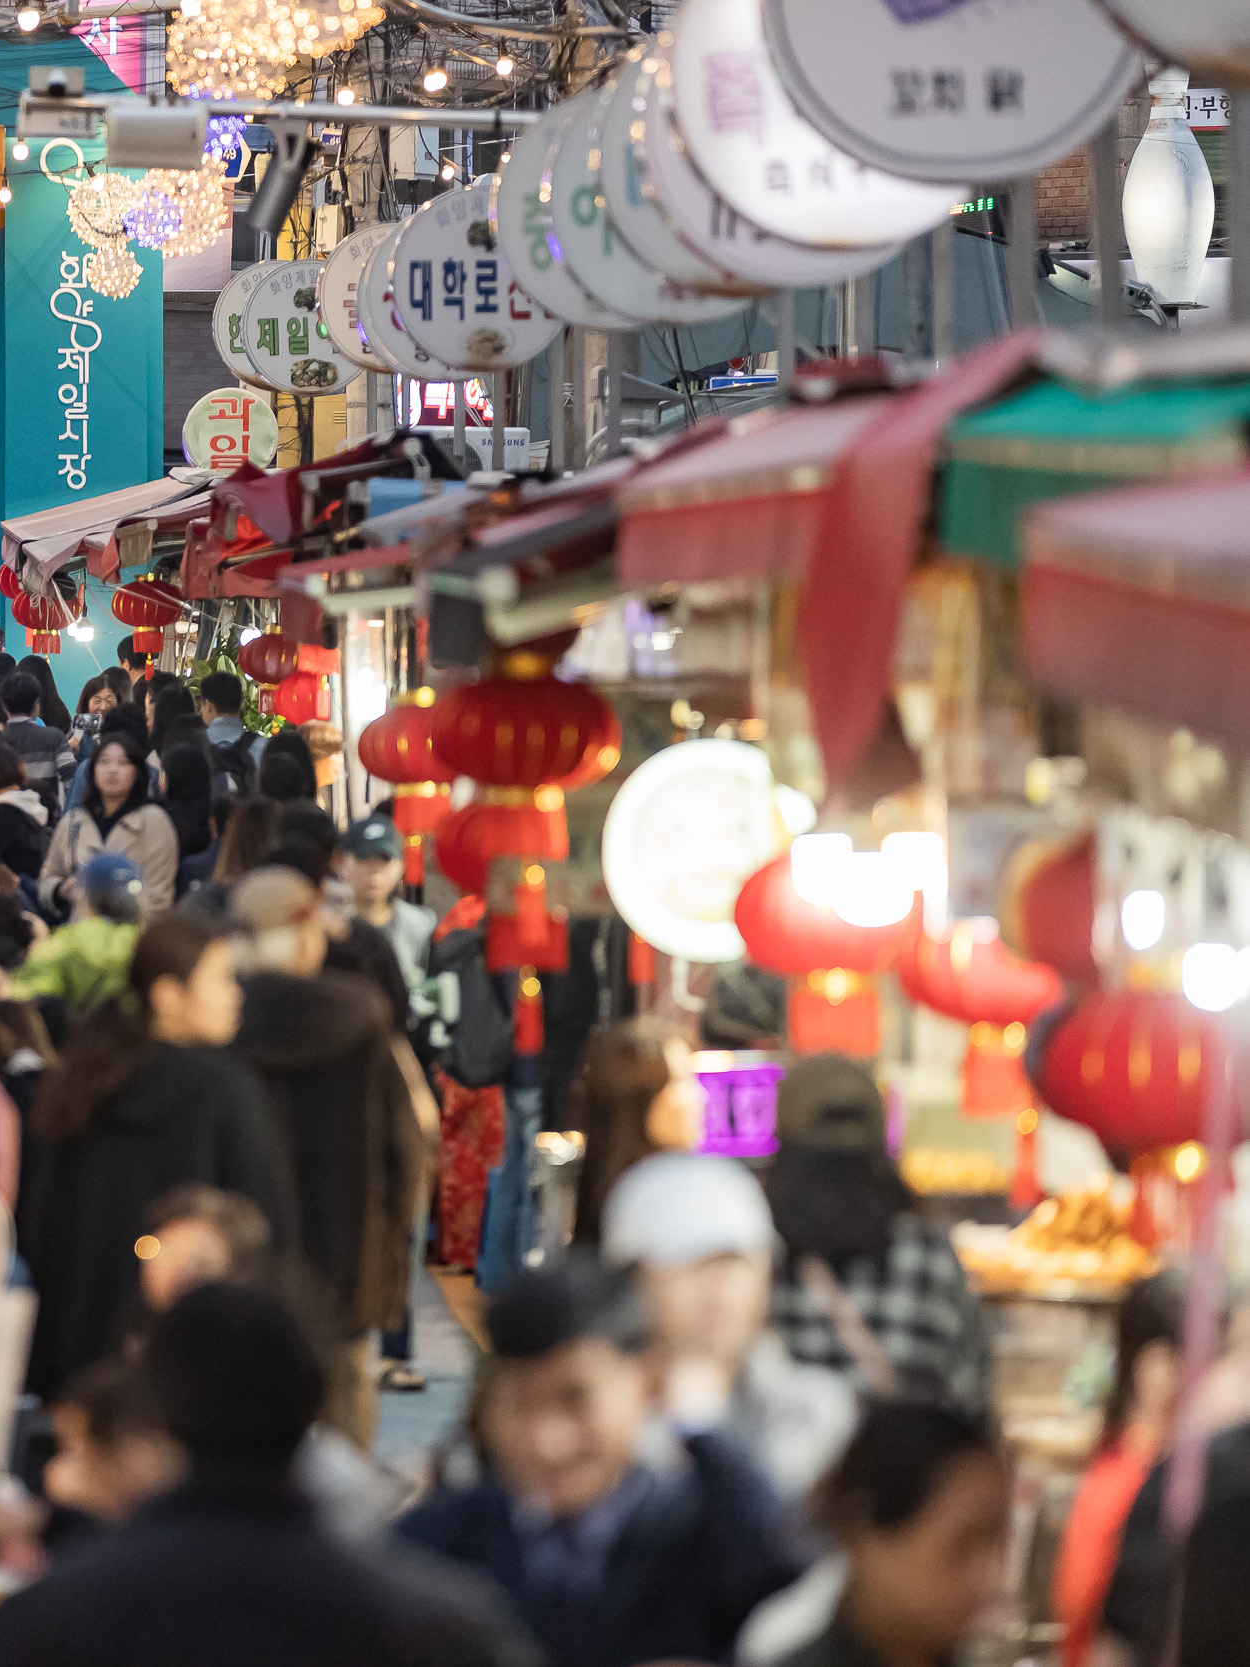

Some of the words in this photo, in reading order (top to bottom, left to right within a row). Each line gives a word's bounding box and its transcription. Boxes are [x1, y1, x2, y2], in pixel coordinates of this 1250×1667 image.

[409, 258, 499, 321] 대학로
[208, 398, 256, 470] 과일
[481, 438, 525, 447] SASUNG
